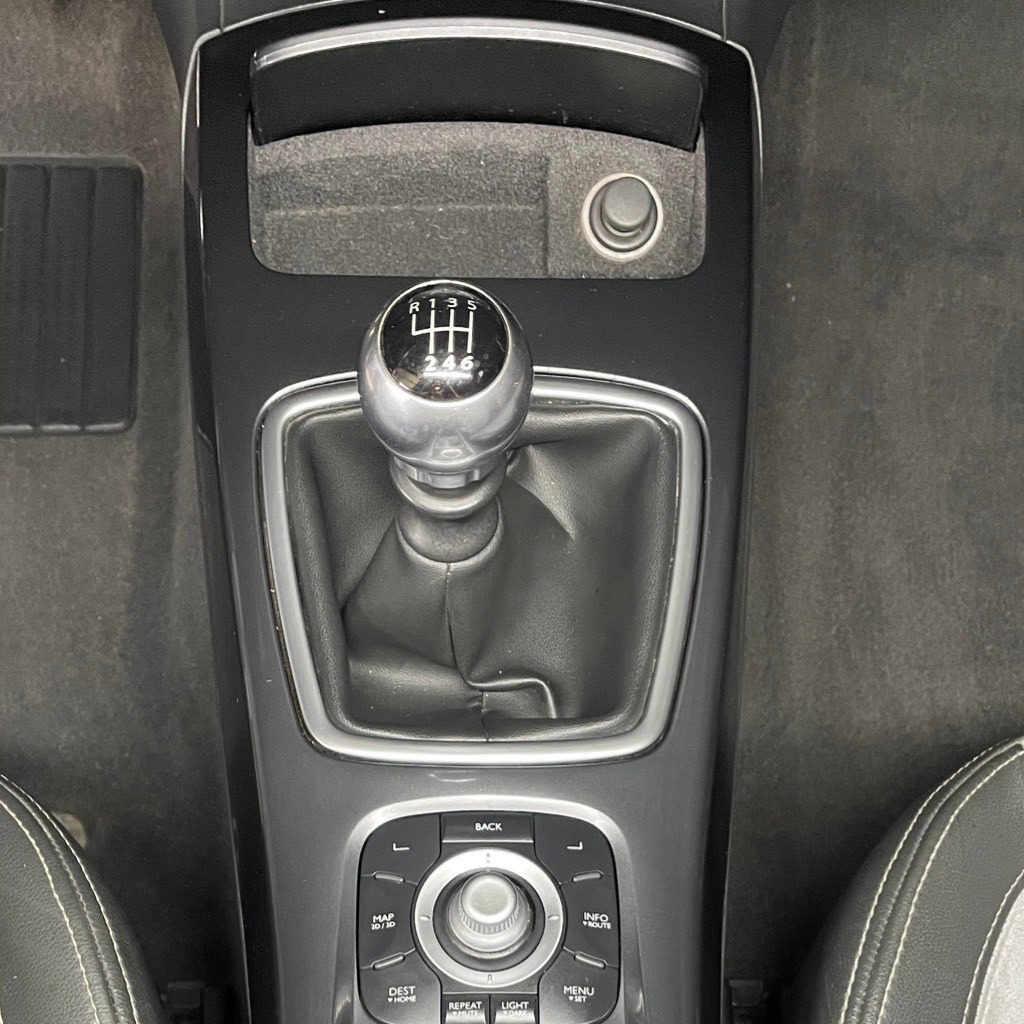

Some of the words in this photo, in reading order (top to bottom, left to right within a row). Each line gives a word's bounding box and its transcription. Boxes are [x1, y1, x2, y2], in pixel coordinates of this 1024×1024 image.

[409, 301, 420, 314] R
[429, 298, 436, 308] 1
[447, 297, 458, 307] 3
[467, 300, 477, 311] 5
[424, 356, 437, 371] 2
[441, 355, 456, 371] 4
[460, 356, 475, 370] 6
[475, 822, 503, 831] BACK
[373, 913, 395, 923] MAP
[583, 912, 609, 922] INFO
[588, 921, 612, 929] ROUTE
[388, 986, 416, 996] DEST
[563, 986, 595, 996] MENU
[574, 995, 587, 1003] SET
[448, 1002, 482, 1011] REPEAT
[501, 1002, 529, 1010] LIGHT
